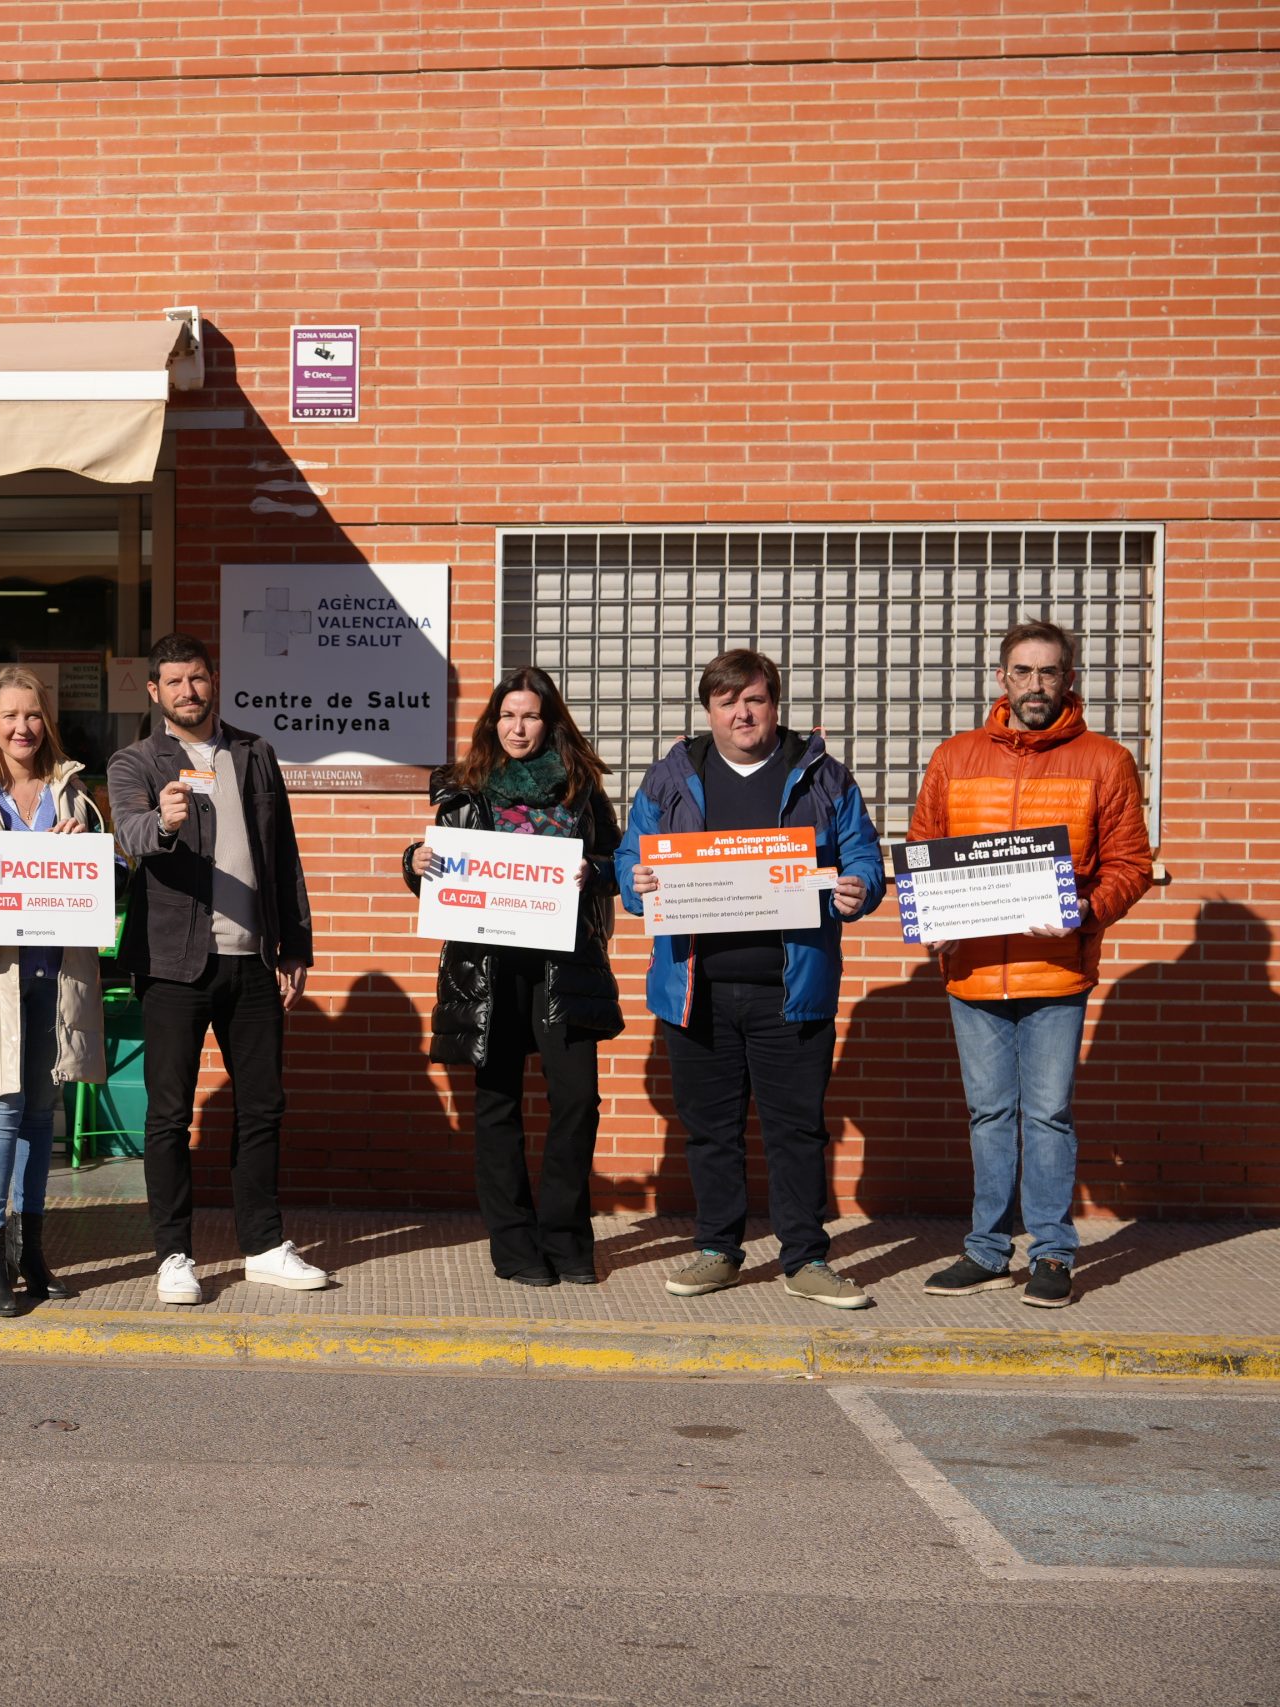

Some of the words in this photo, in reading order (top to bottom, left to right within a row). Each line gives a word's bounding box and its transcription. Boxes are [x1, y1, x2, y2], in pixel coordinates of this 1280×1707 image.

[318, 594, 397, 610] AGÈNCIA
[318, 617, 431, 629] VALENCIANA
[318, 635, 340, 646] DE
[347, 635, 402, 647] SALUT
[235, 692, 312, 708] Centre
[328, 692, 352, 708] de
[368, 692, 430, 708] Salut
[274, 714, 390, 734] Carinyena
[714, 837, 734, 845] Amb
[736, 834, 789, 844] Compromís:
[972, 840, 992, 849] Amb
[995, 838, 1006, 847] PP
[1009, 838, 1011, 846] i
[1014, 836, 1034, 845] Vox:
[697, 847, 721, 856] més
[724, 846, 763, 855] sanitat
[766, 844, 807, 855] pública
[954, 852, 966, 862] la
[968, 849, 990, 860] cita
[991, 846, 1027, 858] arriba
[1030, 841, 1055, 853] tard
[441, 857, 564, 885] IMPACIENTS
[769, 864, 807, 883] SIP
[27, 898, 65, 907] ARRIBA
[67, 898, 92, 907] TARD
[443, 892, 456, 902] LA
[459, 894, 481, 905] CITA
[491, 897, 527, 908] ARRIBA
[530, 900, 555, 911] TARD
[678, 897, 703, 905] plantilla
[680, 913, 698, 921] temps
[756, 909, 778, 917] pacient
